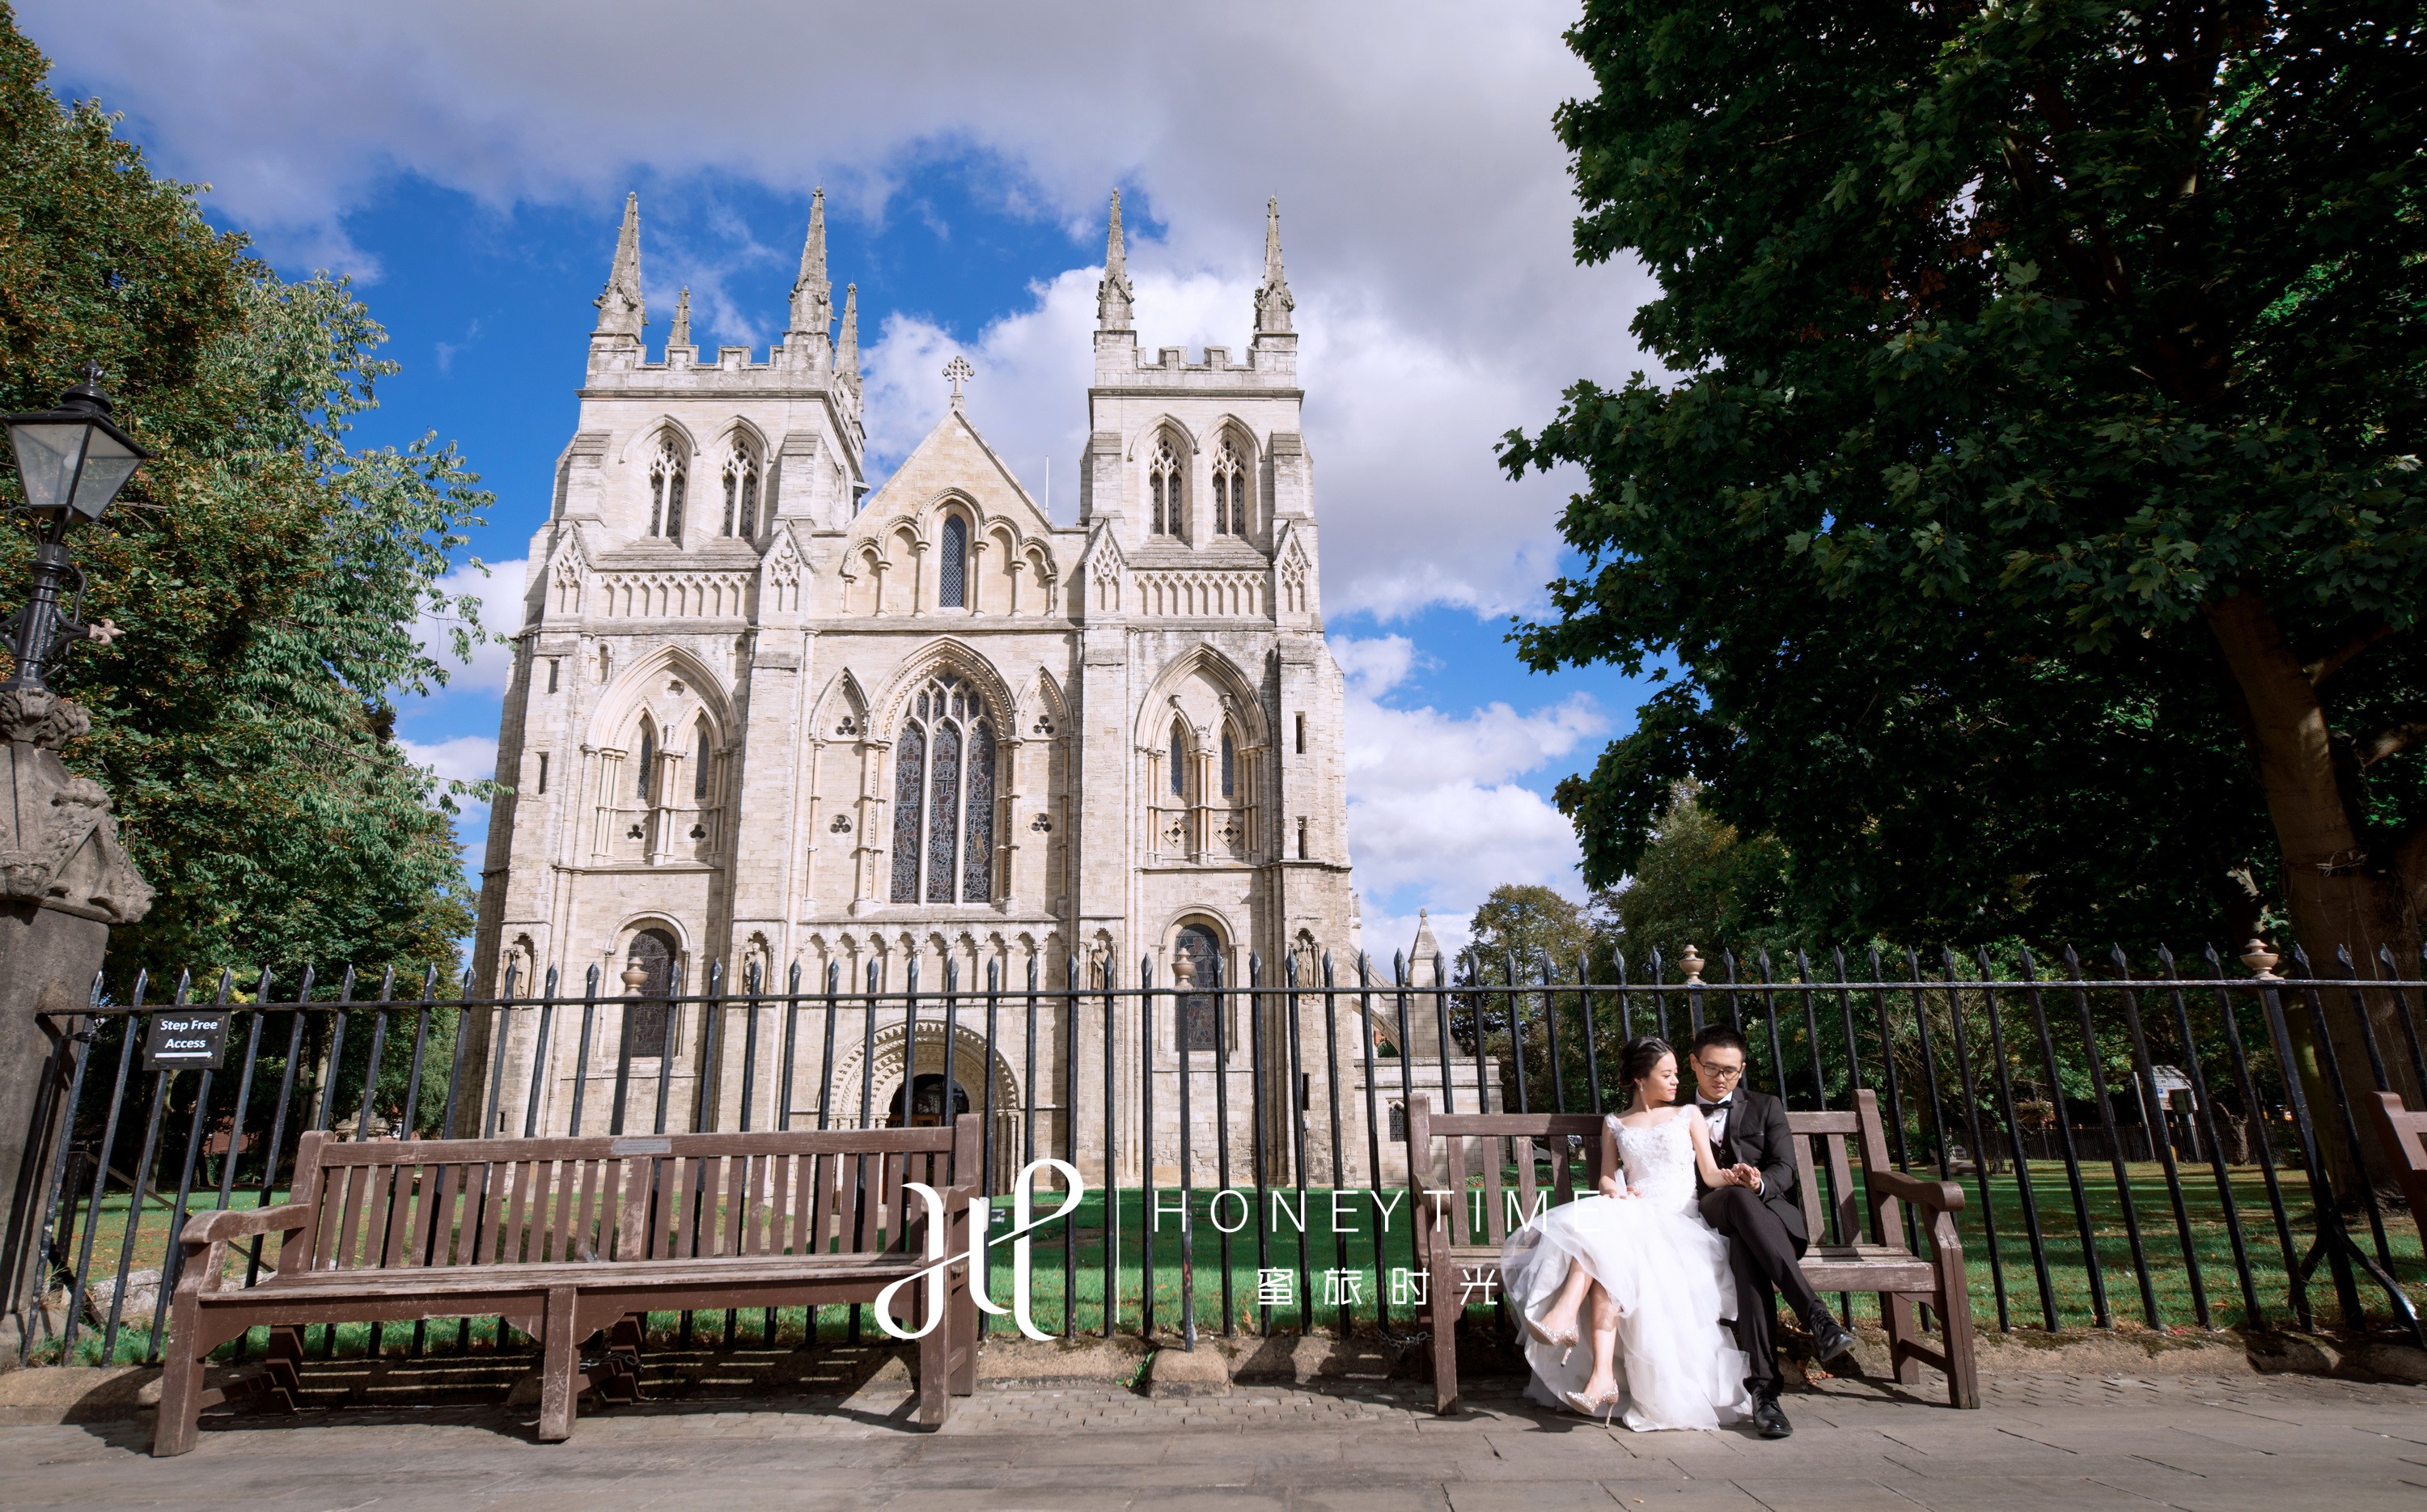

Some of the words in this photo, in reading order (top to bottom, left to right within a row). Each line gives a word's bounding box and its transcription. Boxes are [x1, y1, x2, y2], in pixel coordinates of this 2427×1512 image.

[160, 1020, 188, 1032] Step
[191, 1019, 218, 1030] Free
[164, 1038, 206, 1048] Access
